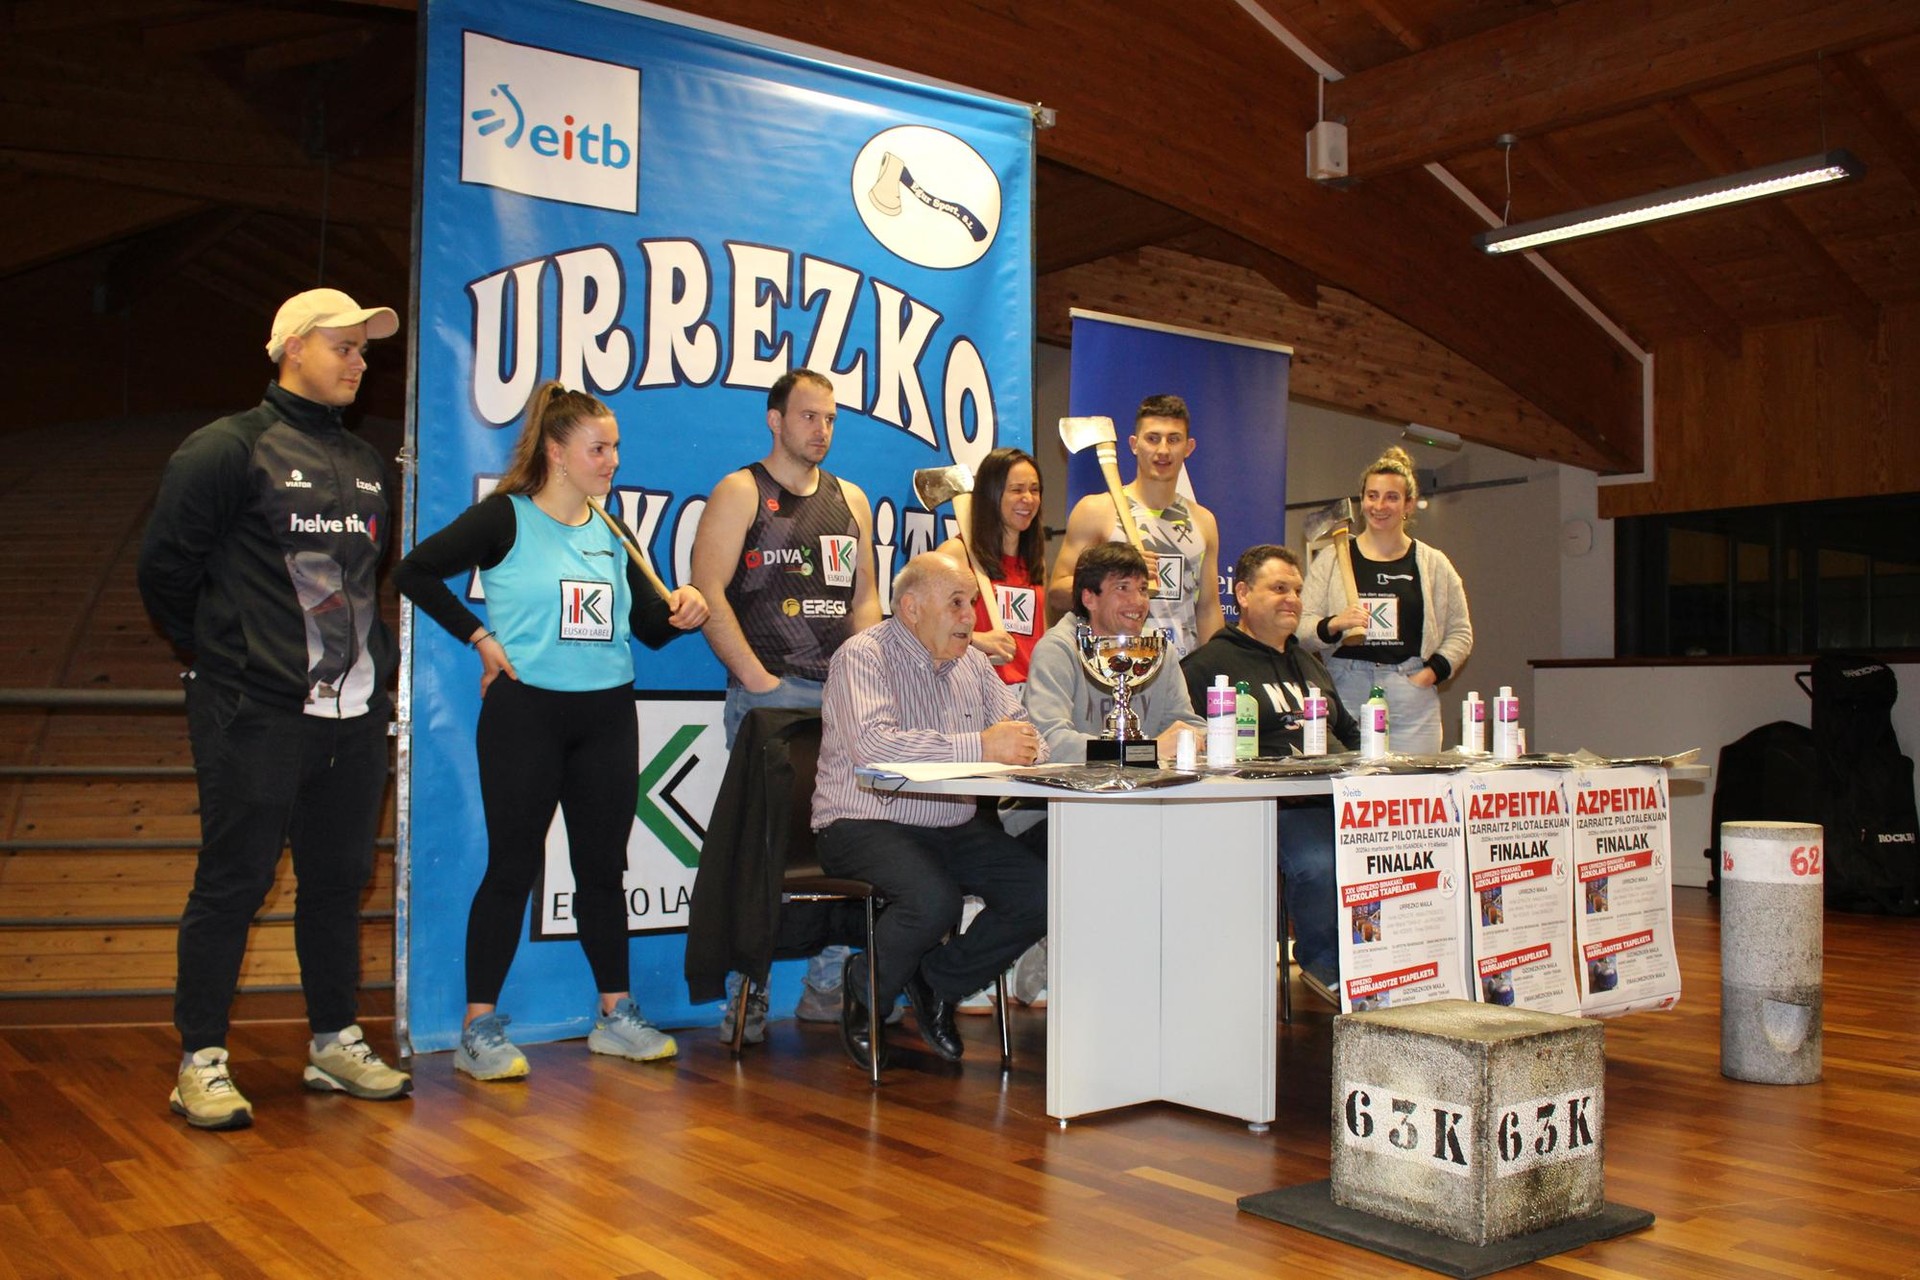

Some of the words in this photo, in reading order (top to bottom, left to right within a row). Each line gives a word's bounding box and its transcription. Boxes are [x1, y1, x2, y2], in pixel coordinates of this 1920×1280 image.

[530, 114, 631, 170] eitb
[467, 237, 998, 478] URREZKO
[763, 549, 803, 565] DIVA
[564, 627, 588, 636] EUSKO
[589, 628, 610, 637] LABEL
[1468, 790, 1559, 820] AZPEITIA
[1576, 786, 1657, 815] AZPEITIA
[1340, 797, 1448, 829] AZPEITIA
[1577, 817, 1613, 829] IZARRAITZ
[1615, 812, 1667, 826] PILOTALEKUAN
[1340, 832, 1389, 845] IZARRAITZ
[1392, 827, 1461, 841] PILOTALEKUAN
[1469, 822, 1509, 835] IZARRAITZ
[1512, 818, 1570, 833] PILOTALEKUAN
[1490, 840, 1549, 862] FINALAK
[1596, 833, 1649, 854] FINALAK
[1367, 851, 1434, 875] FINALAK
[1790, 845, 1821, 876] 62
[1346, 890, 1379, 903] AIZKOLARI
[1380, 882, 1417, 896] TXAPELKETA
[1399, 968, 1435, 983] TXAPELKETA
